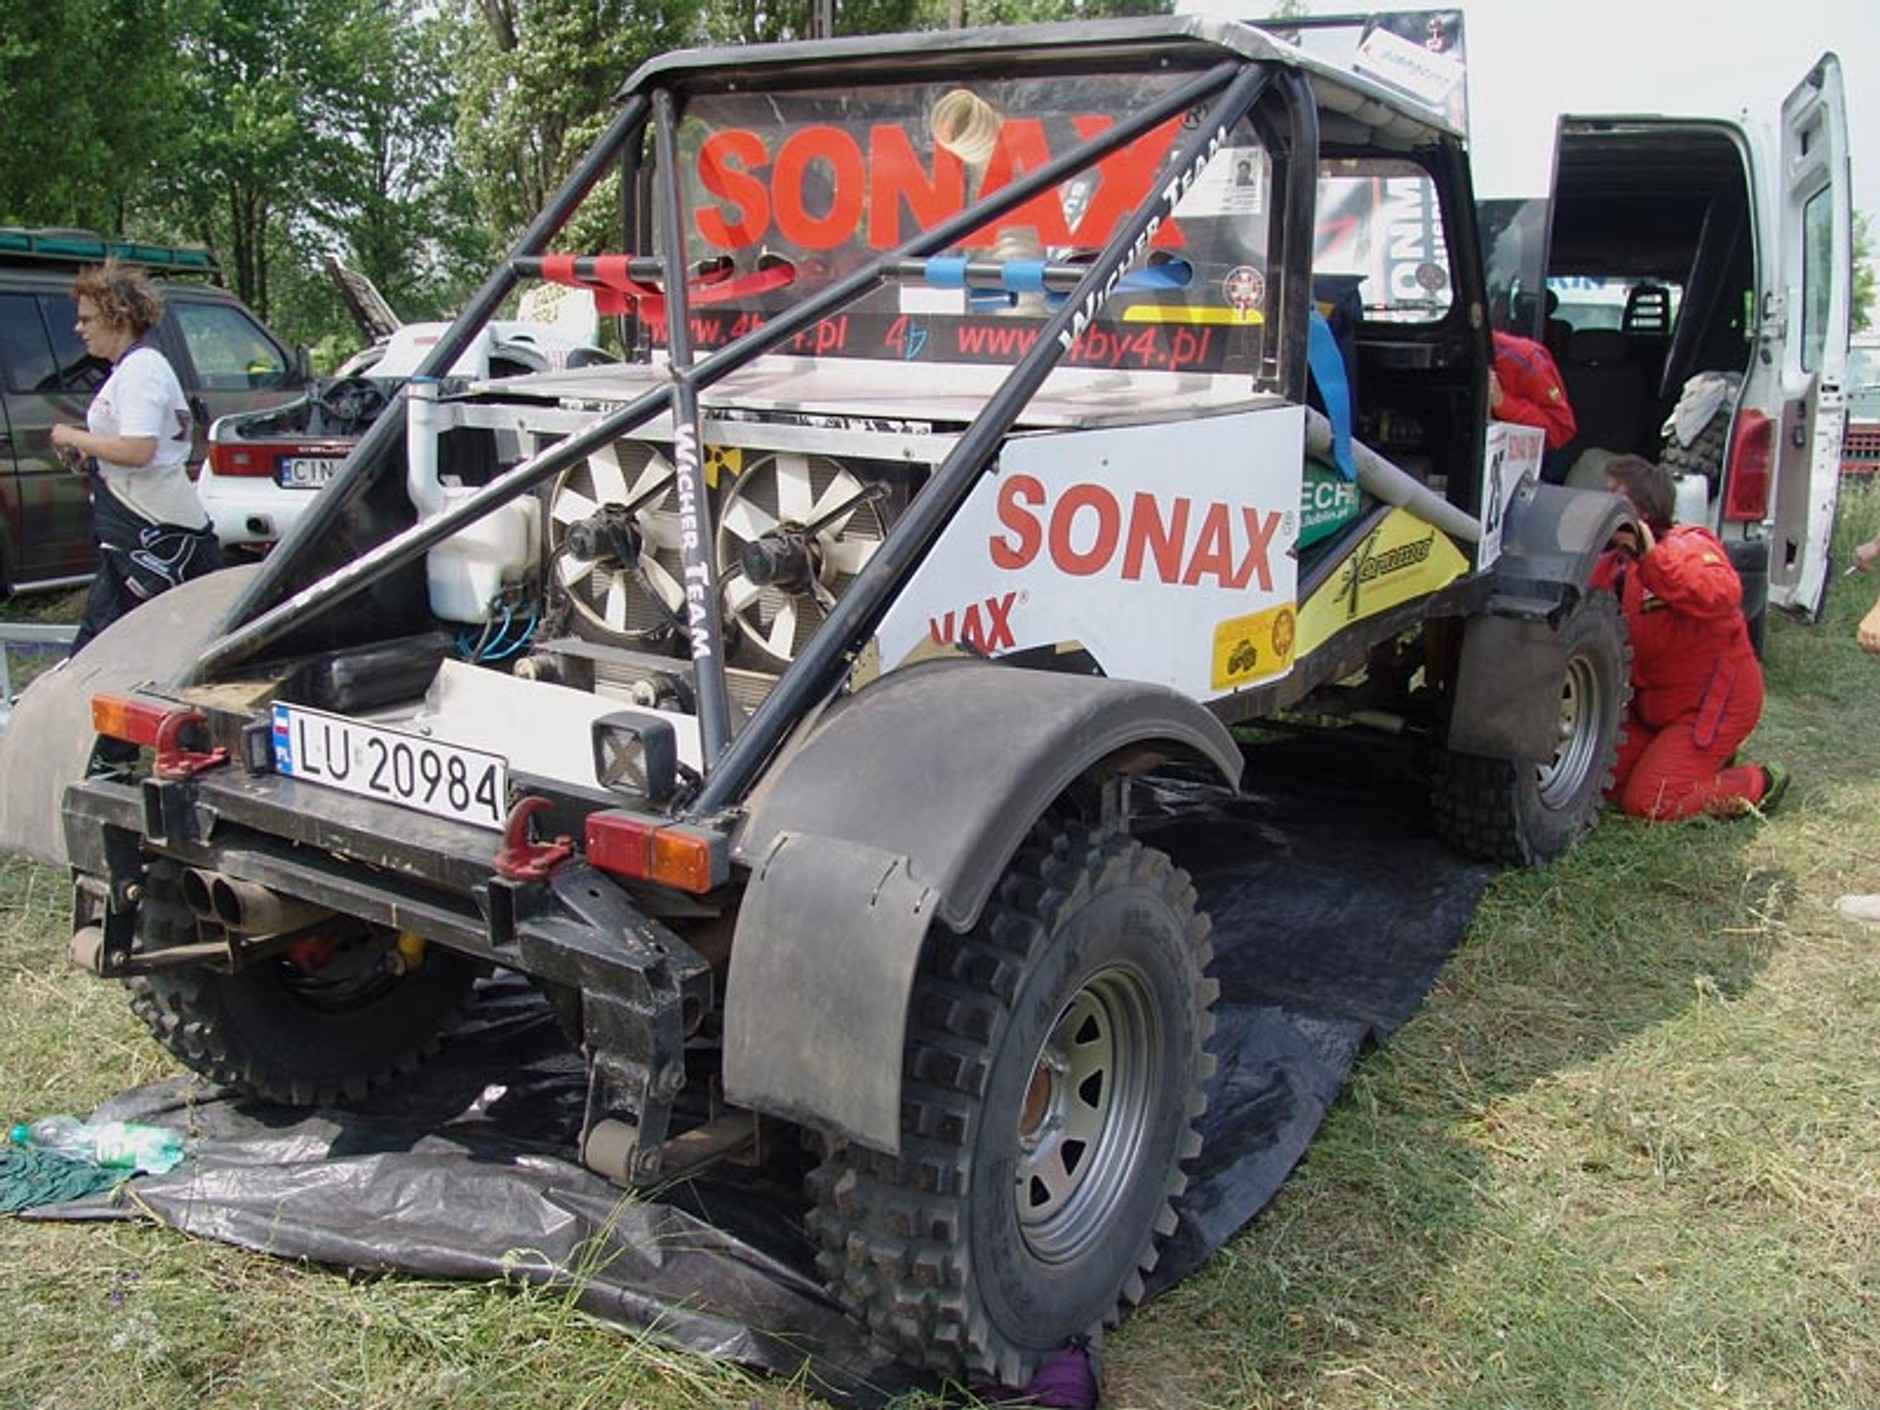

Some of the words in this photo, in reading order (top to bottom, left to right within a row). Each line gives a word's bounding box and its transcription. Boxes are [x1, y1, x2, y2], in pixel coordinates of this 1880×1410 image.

[693, 114, 1188, 251] SONAX
[1058, 215, 1161, 352] WICHER
[1162, 125, 1227, 211] TEAM
[674, 423, 700, 551] WICHER
[989, 474, 1283, 593] SONAX
[685, 561, 712, 660] TEAM
[298, 718, 350, 781] LU
[368, 737, 500, 822] 20984
